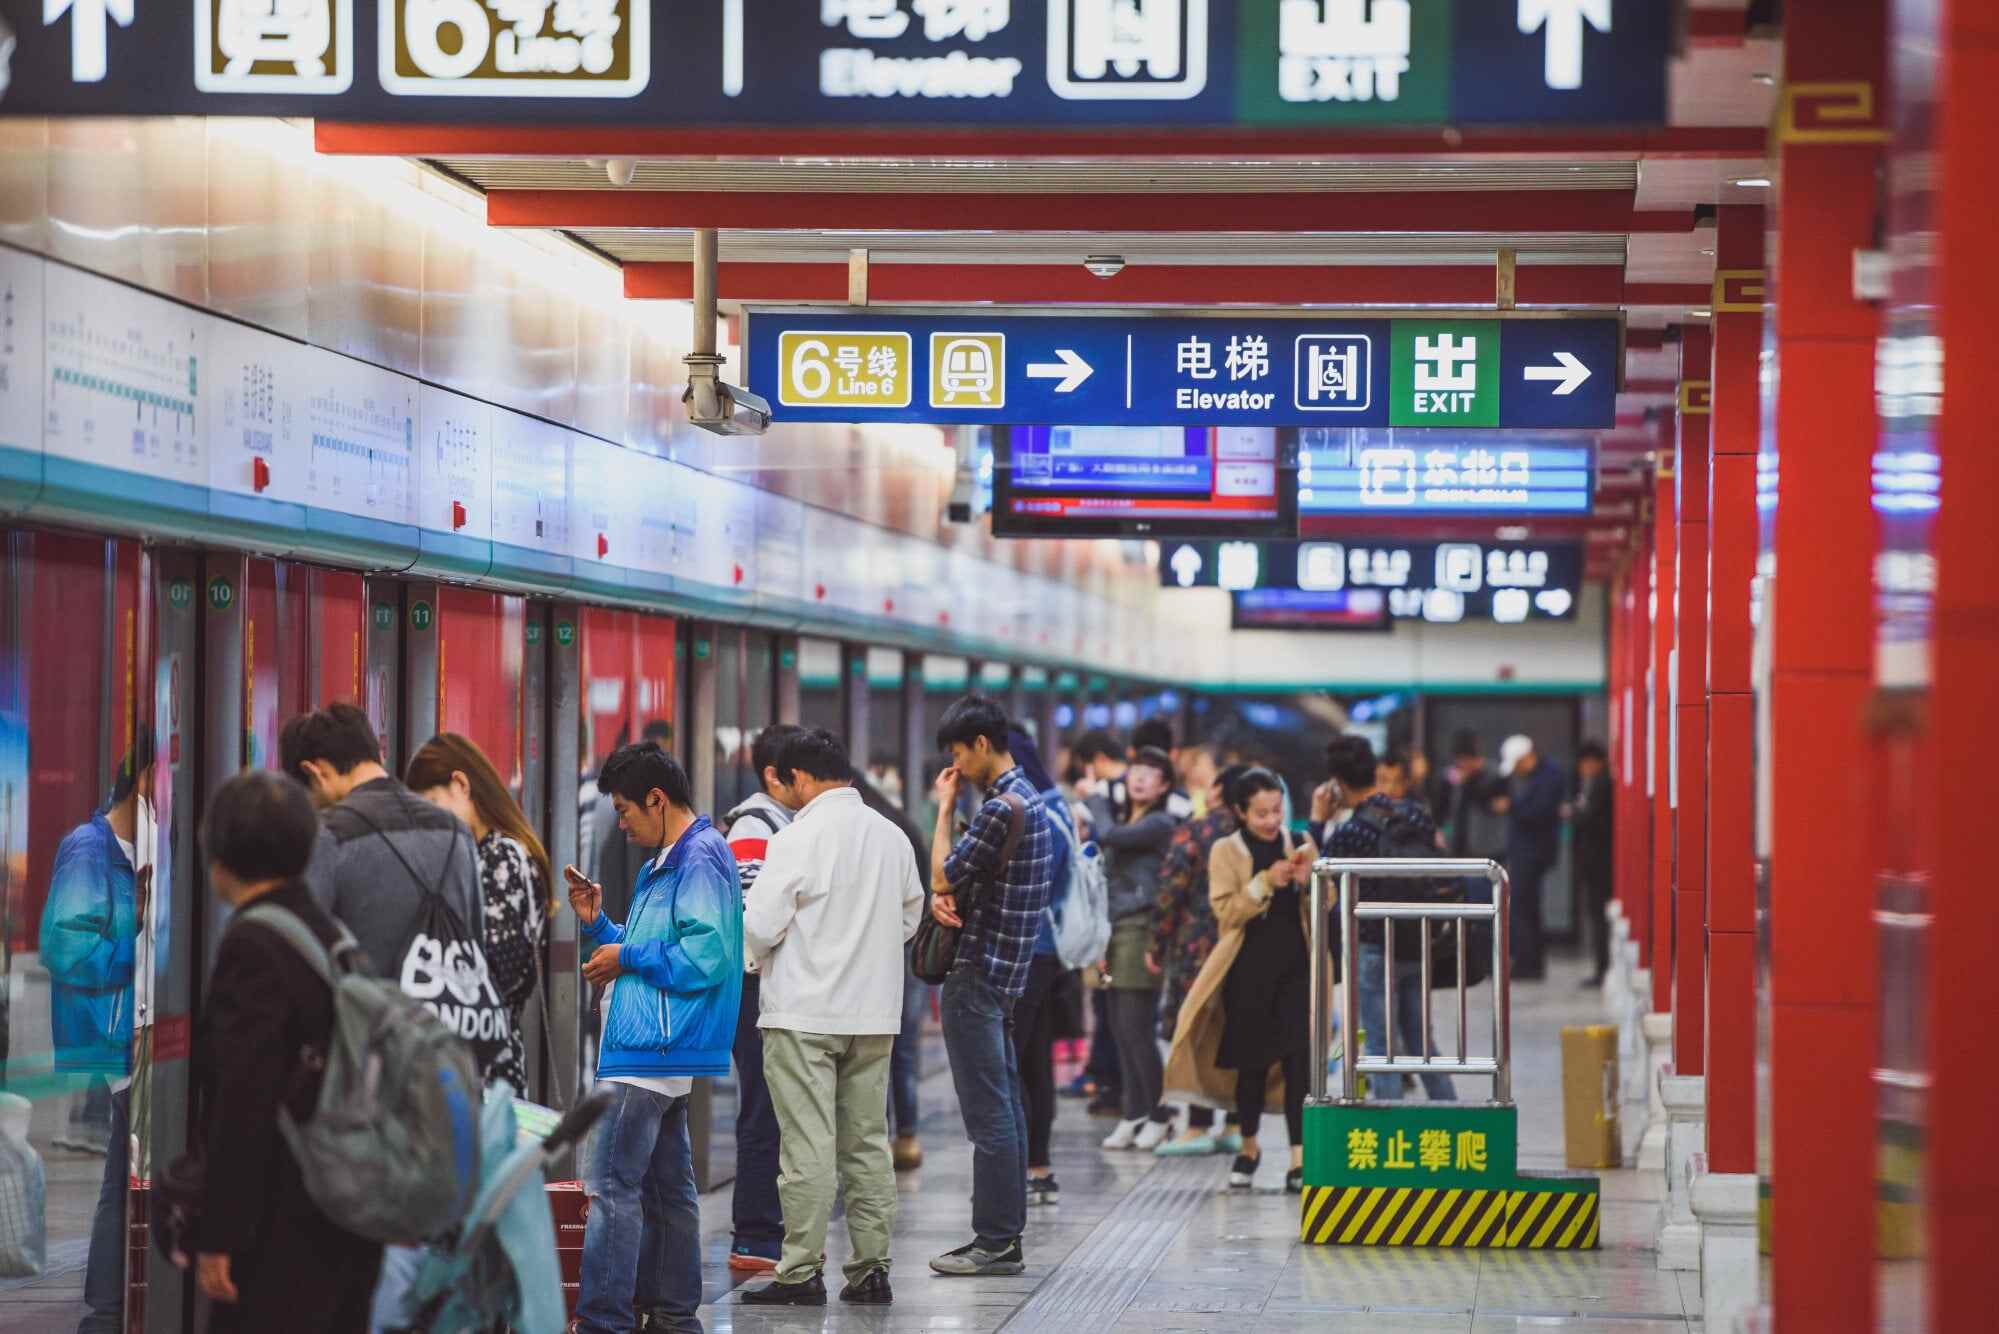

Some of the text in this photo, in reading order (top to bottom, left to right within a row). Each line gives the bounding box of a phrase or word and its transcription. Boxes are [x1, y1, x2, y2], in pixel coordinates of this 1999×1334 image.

[1279, 56, 1410, 102] EXIT
[1176, 335, 1270, 381] 电梯
[1414, 333, 1476, 391] 出
[837, 378, 894, 395] Line 6
[1176, 388, 1275, 410] Elevator
[1414, 393, 1476, 413] EXIT
[210, 584, 231, 601] 10
[414, 609, 429, 623] 11
[558, 627, 572, 639] 12
[1346, 1128, 1488, 1172] 禁止攀爬
